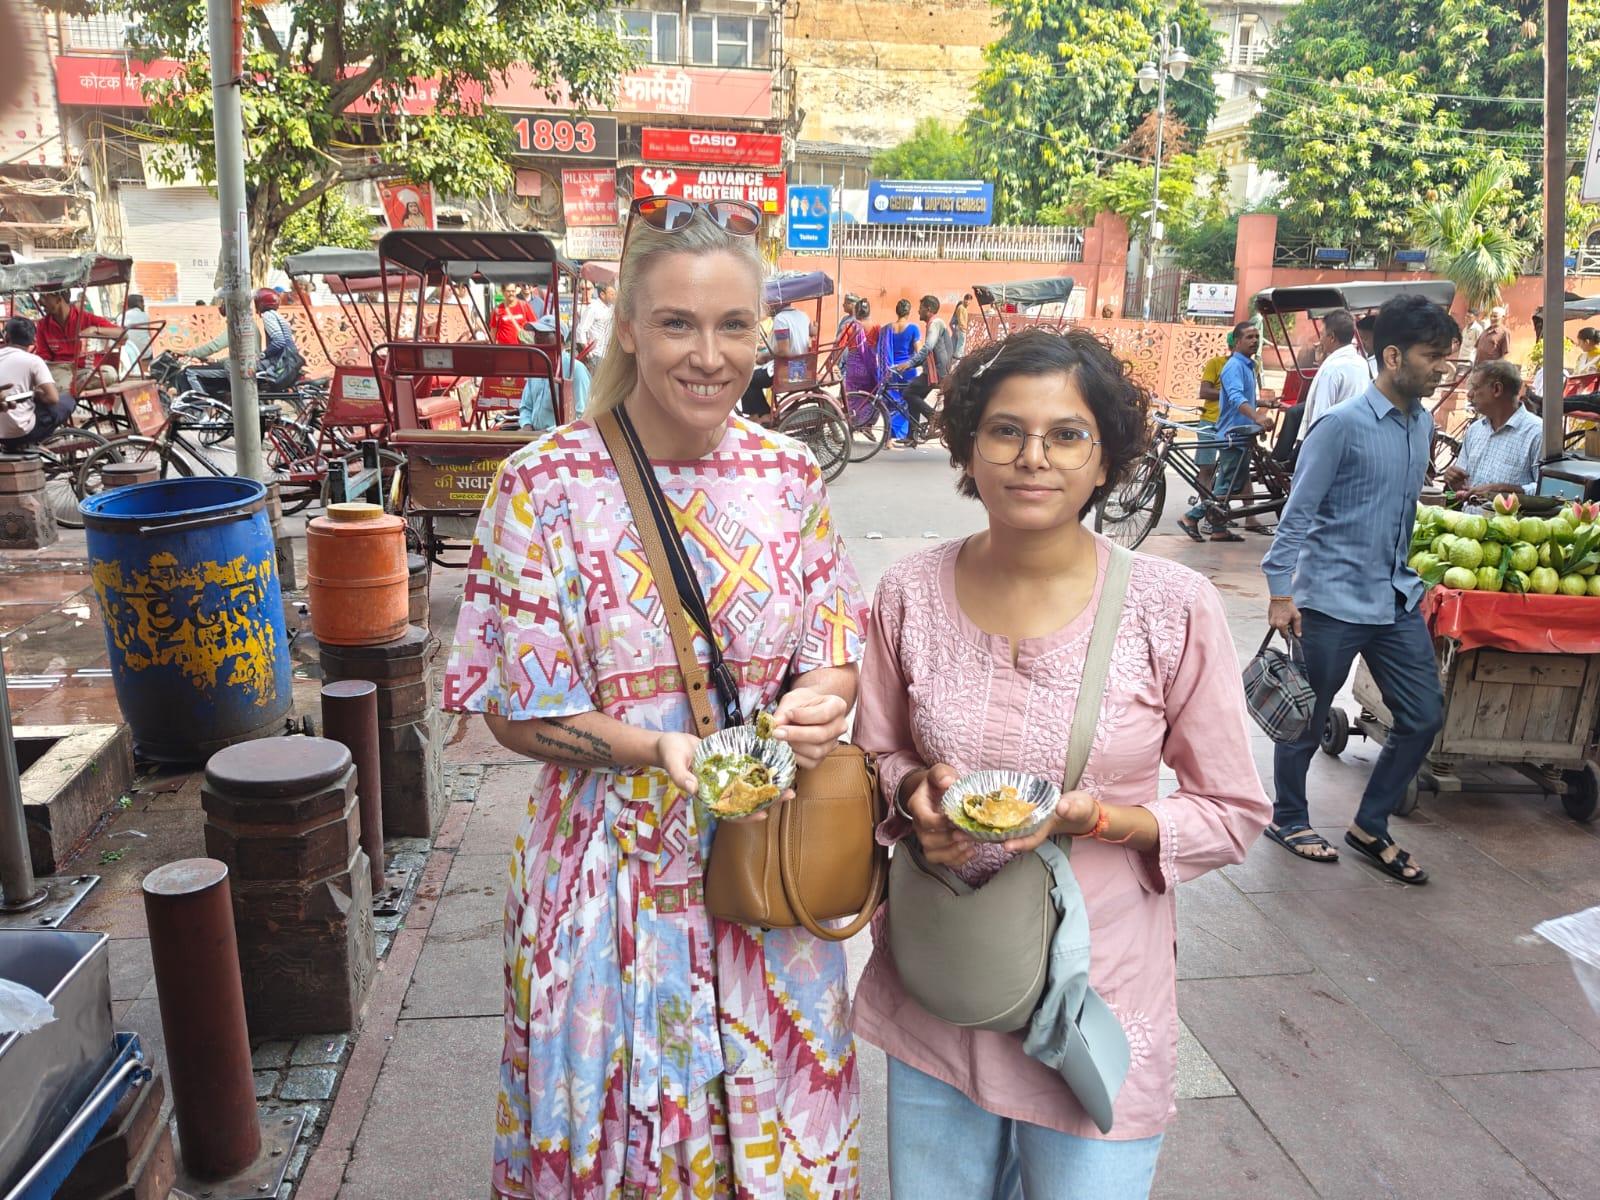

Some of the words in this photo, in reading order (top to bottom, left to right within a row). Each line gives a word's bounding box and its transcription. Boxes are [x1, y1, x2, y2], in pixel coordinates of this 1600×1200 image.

[80, 72, 120, 90] कोटक
[513, 118, 596, 153] 1893
[689, 134, 737, 147] CASIO
[698, 171, 764, 186] ADVANCE
[682, 184, 744, 201] PROTEIN
[748, 187, 778, 201] HUB
